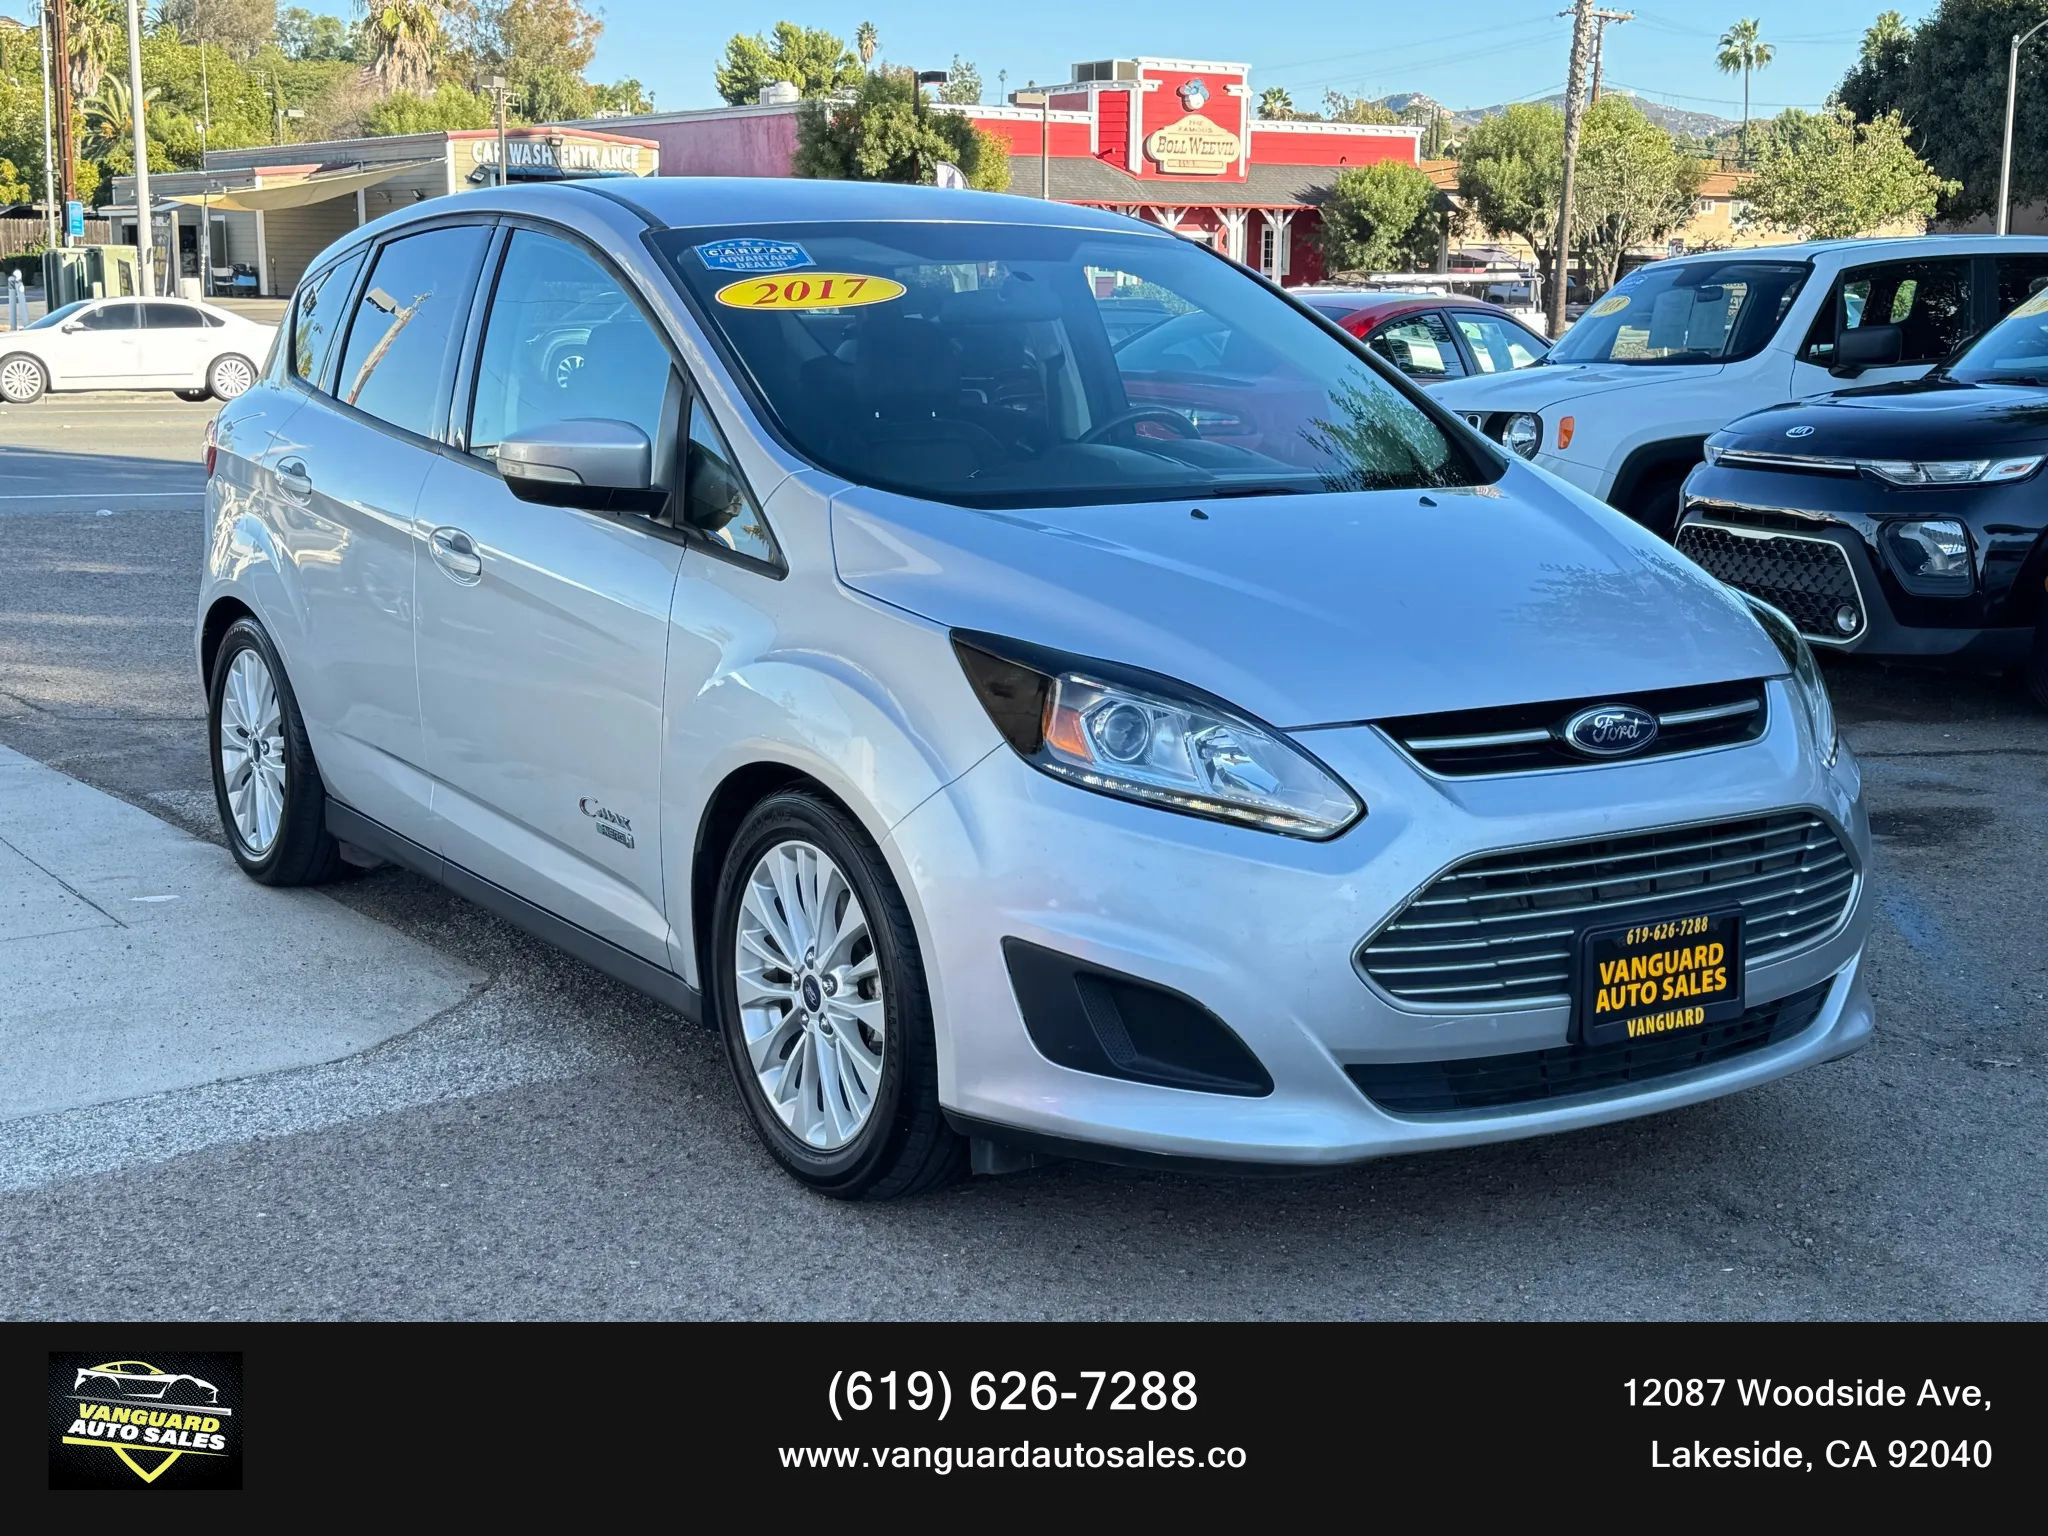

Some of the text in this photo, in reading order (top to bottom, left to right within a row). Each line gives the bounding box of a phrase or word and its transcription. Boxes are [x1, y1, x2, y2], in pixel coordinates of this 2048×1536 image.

[509, 143, 552, 166] WASH
[560, 145, 640, 169] ENTRANCE
[1156, 135, 1235, 156] BOLL WEEVIL
[704, 246, 800, 257] CARFAX
[719, 252, 796, 264] ADVANTAGE
[736, 260, 789, 269] DEALER
[753, 278, 869, 305] 2017
[1593, 713, 1641, 744] Ford
[1626, 915, 1709, 945] 619-626-7288
[1599, 942, 1725, 986] VANGUARD
[1595, 966, 1728, 1014] AUTO SALES
[1626, 1007, 1705, 1039] VANGUARD
